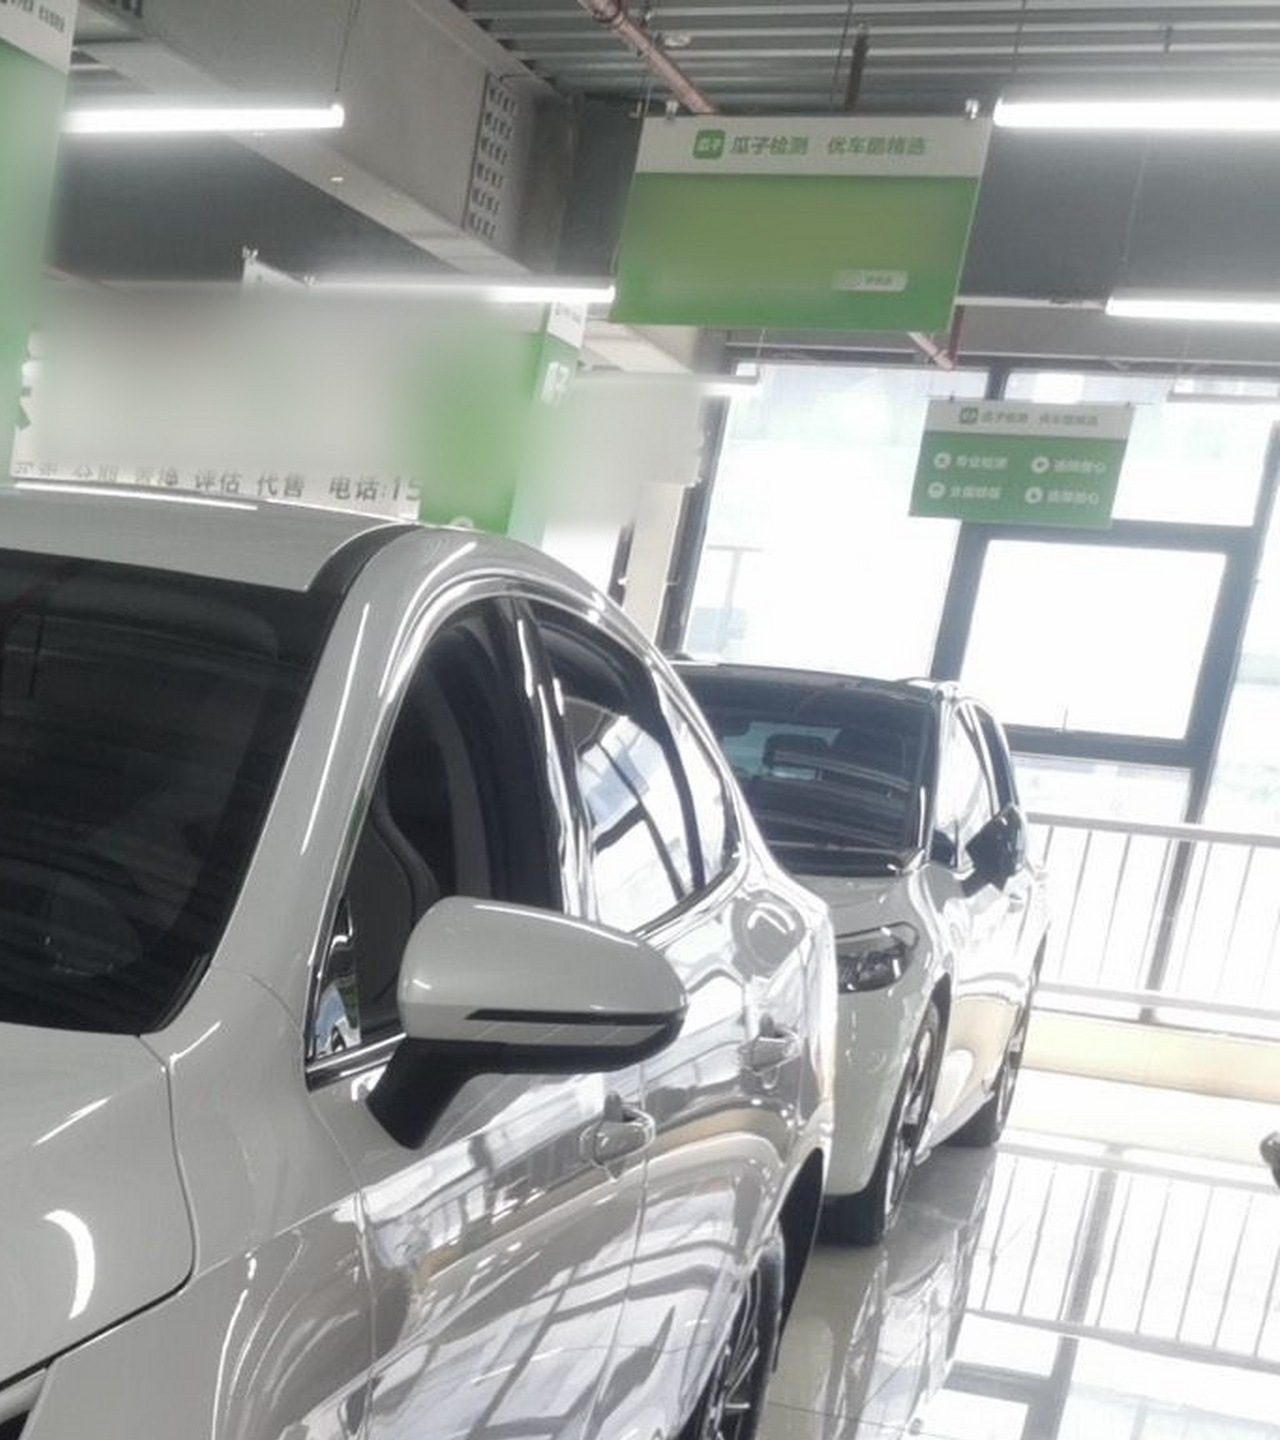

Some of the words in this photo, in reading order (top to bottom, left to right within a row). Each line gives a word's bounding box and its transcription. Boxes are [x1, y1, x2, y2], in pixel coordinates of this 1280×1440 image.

[732, 136, 810, 156] 瓜子检测
[194, 468, 244, 495] 评估
[257, 471, 307, 499] 代售
